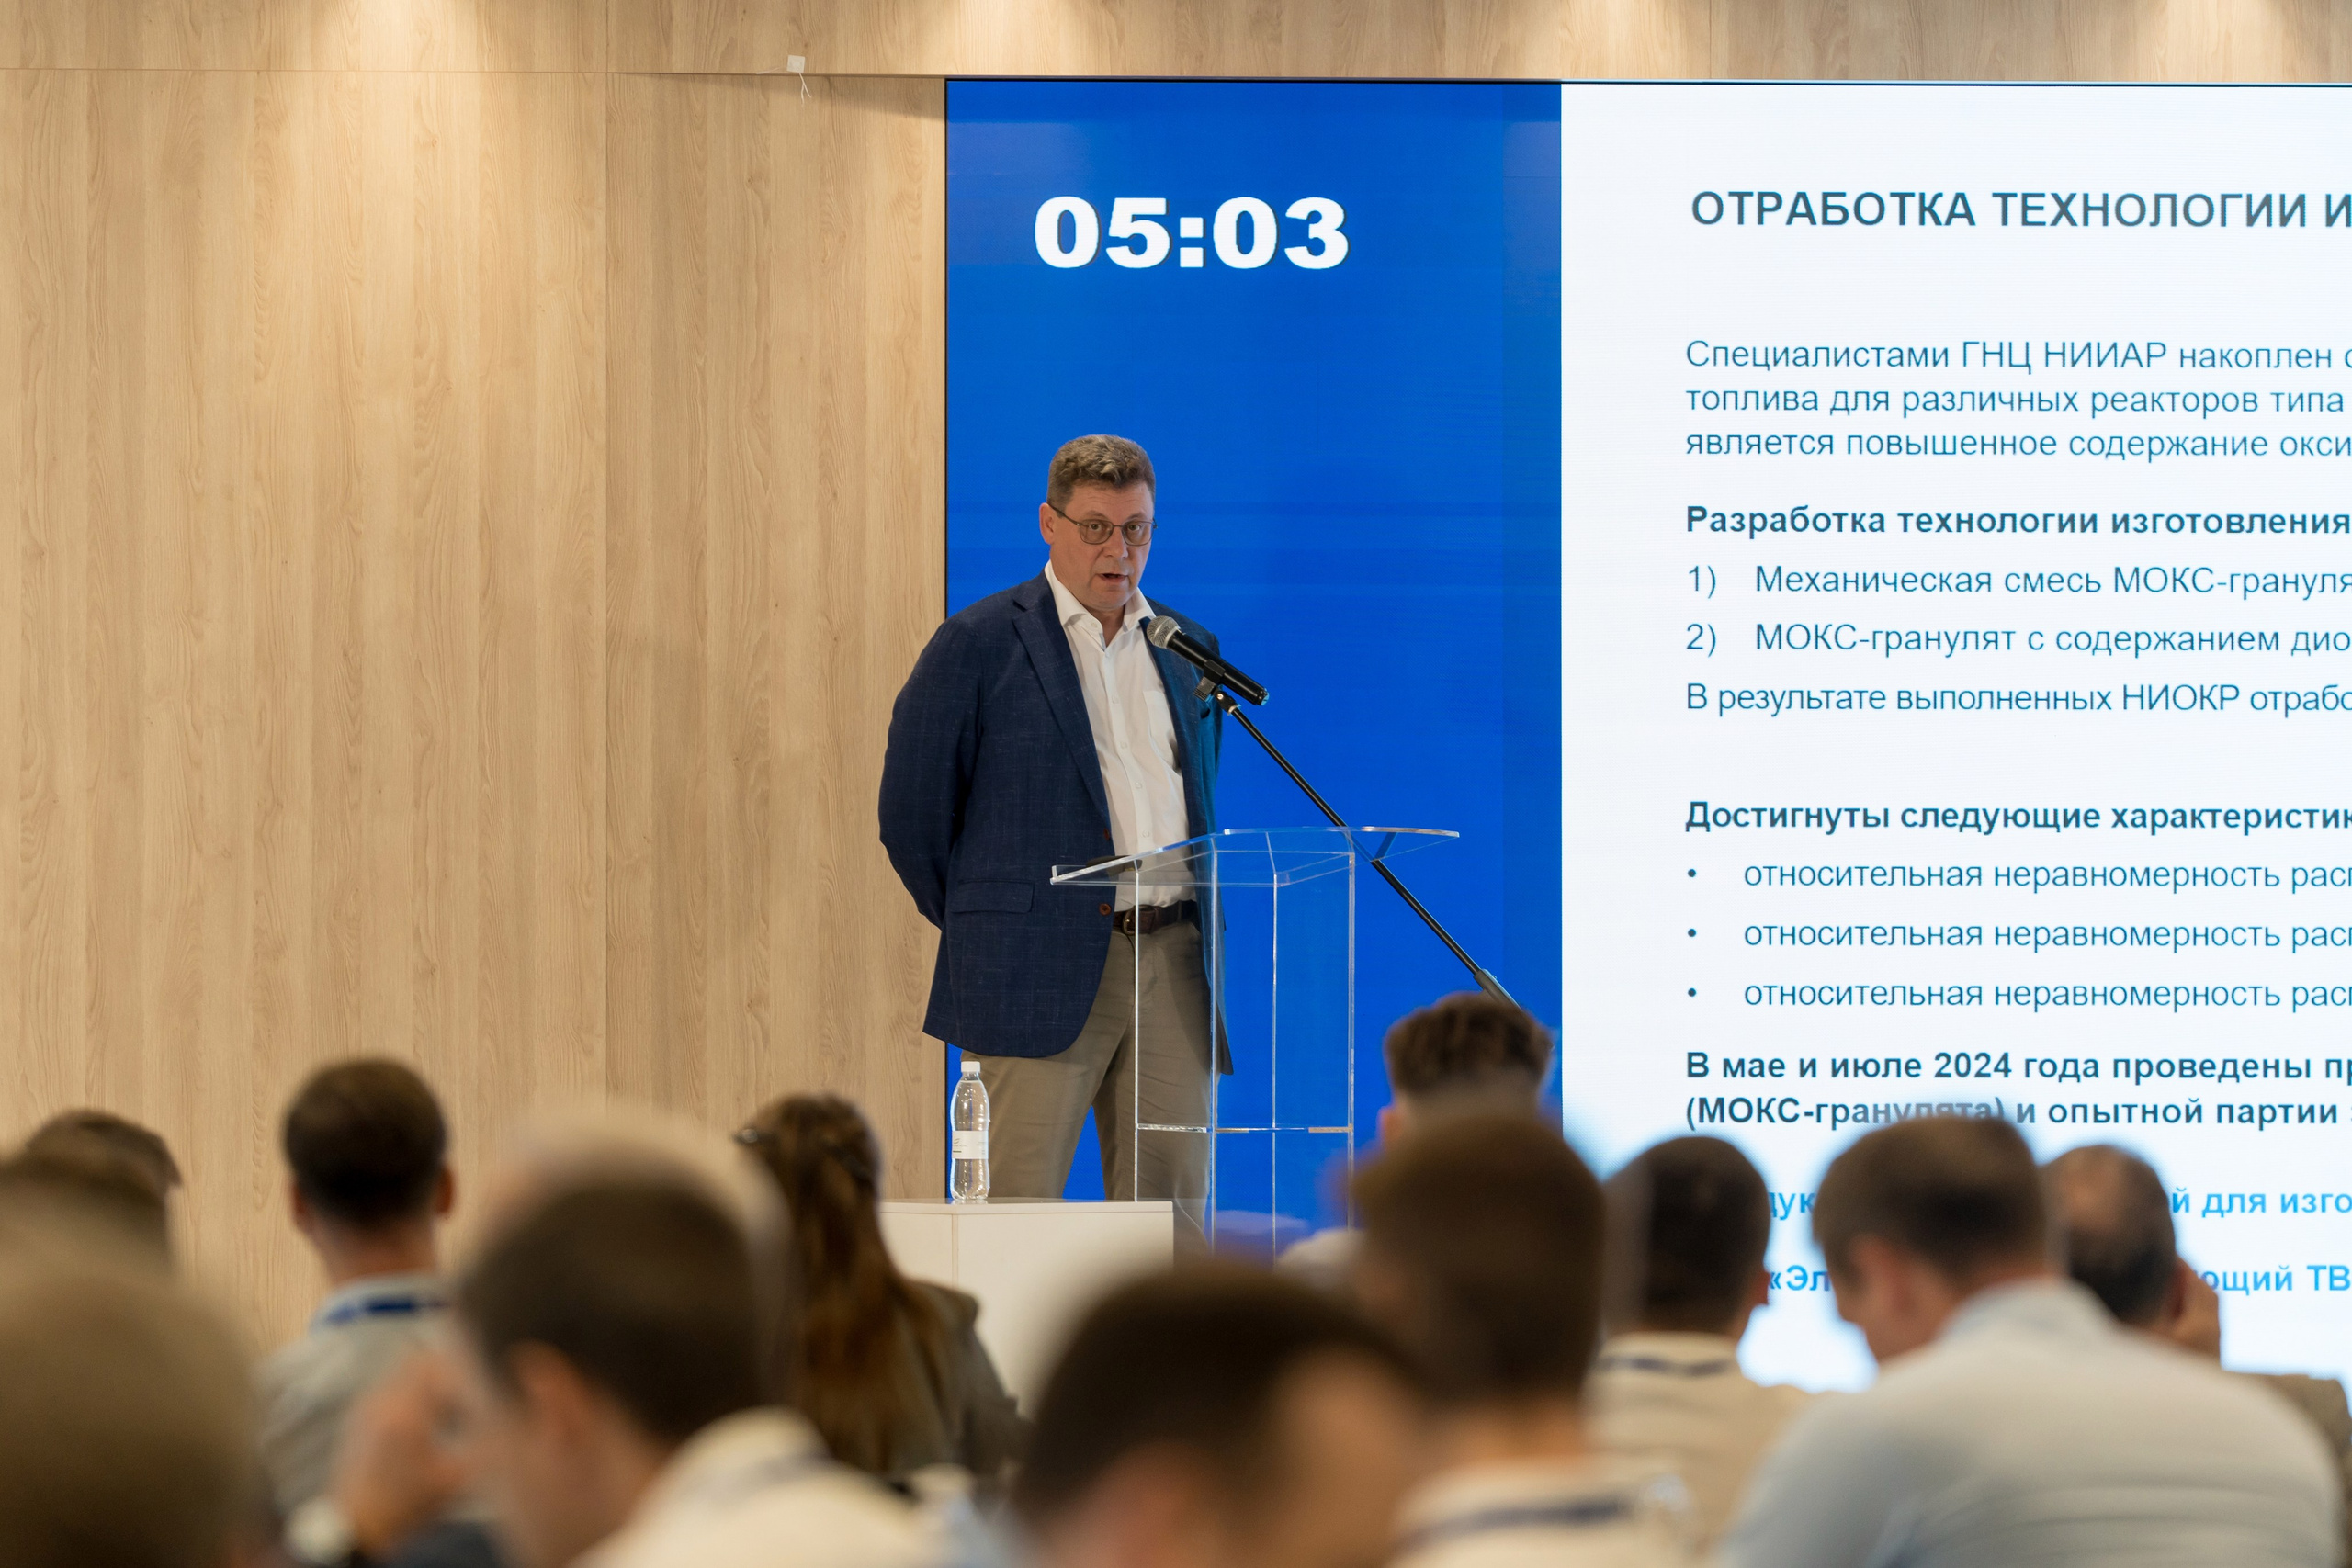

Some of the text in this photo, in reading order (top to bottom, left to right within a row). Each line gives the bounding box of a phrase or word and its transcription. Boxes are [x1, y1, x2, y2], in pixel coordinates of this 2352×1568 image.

[1692, 190, 2352, 228] ОТРАБОТКА ТЕХНОЛОГИИ И
[1035, 195, 1349, 270] 05:03
[1687, 340, 1949, 372] Специалистами
[1963, 341, 2032, 375] ГНЦ
[2045, 342, 2167, 369] НИИАР
[2180, 348, 2332, 369] накоплен
[1686, 390, 2344, 420] топлива для различных реакторов типа
[1686, 434, 2352, 464] является повышенное содержание окси
[1688, 505, 2351, 539] Разработка технологии изготовления
[1688, 565, 1717, 599] 1)
[1757, 566, 1991, 592] Механическая
[2005, 572, 2101, 593] смесь
[1687, 624, 2352, 659] 2) МОКС-гранулят с содержанием дио
[1688, 683, 1707, 710] В
[1719, 690, 1886, 717] результате
[1897, 690, 2113, 711] выполненных
[2123, 684, 2240, 711] НИОКР
[1685, 801, 1890, 836] Достигнуты
[1901, 808, 2100, 836] следующие
[1745, 866, 2352, 895] относительная неравномерность рас
[1745, 926, 2352, 954] относительная неравномерность рас
[1745, 986, 2352, 1014] относительная неравномерность рас
[1687, 1052, 1709, 1078] В
[1724, 1058, 1786, 1079] мае
[1799, 1058, 1817, 1078] и
[1831, 1058, 1922, 1079] июле
[1935, 1052, 2012, 1079] 2024
[2025, 1058, 2099, 1084] года
[2113, 1058, 2311, 1086] проведены
[2017, 1103, 2036, 1123] и
[2048, 1098, 2202, 1124] опытной
[2217, 1104, 2337, 1133] партии
[2201, 1193, 2267, 1219] для
[2280, 1193, 2352, 1213] изго
[2306, 1265, 2352, 1292] ТВ
